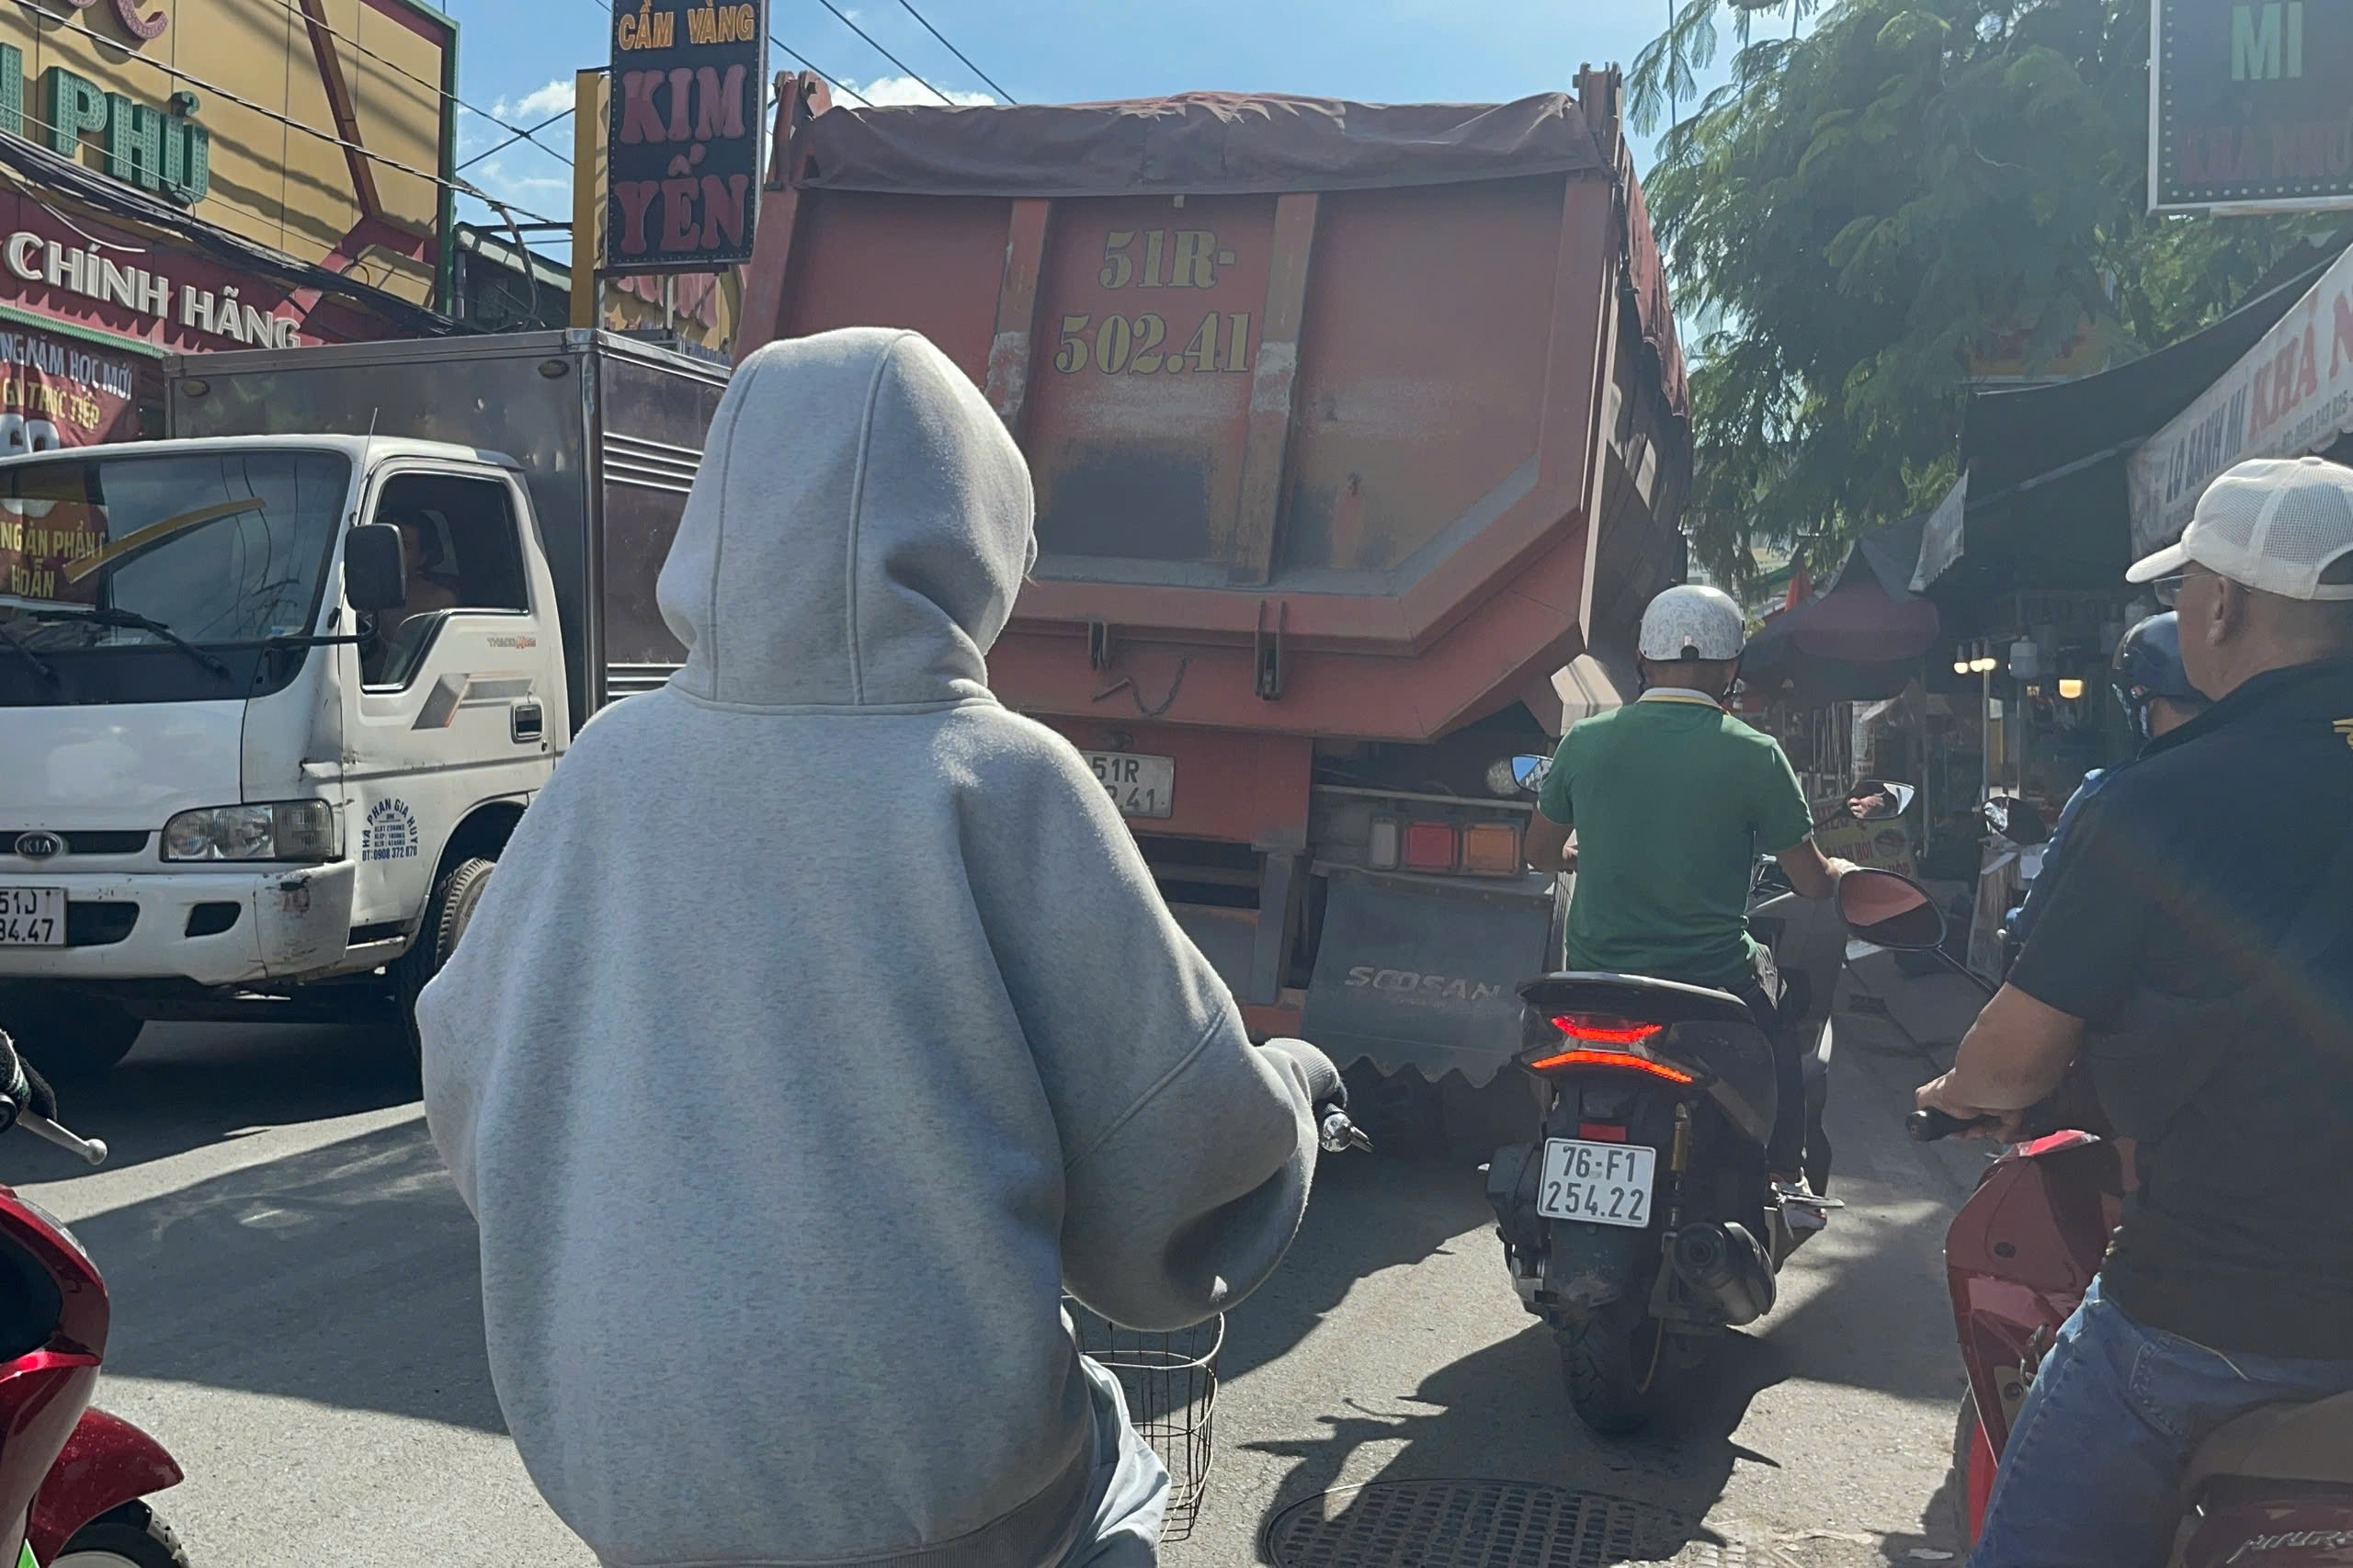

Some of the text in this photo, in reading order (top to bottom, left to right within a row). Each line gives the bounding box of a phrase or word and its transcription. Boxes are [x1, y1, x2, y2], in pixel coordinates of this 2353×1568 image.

[620, 64, 746, 142] KIM
[614, 142, 749, 253] YẾN
[1098, 229, 1235, 290] 51R-
[3, 232, 301, 349] CHÍNH HÃNG
[26, 335, 64, 378] NĂM
[69, 349, 99, 393] HỌC
[102, 361, 132, 401] MỚI
[1054, 311, 1251, 374] 502.41
[1092, 756, 1140, 784] 51R
[23, 839, 52, 853] KIA
[367, 797, 391, 826] PHAN
[394, 798, 409, 818] GIA
[406, 815, 418, 844] HUY
[1563, 1145, 1636, 1183] 76-F1
[1544, 1180, 1644, 1221] 254.22
